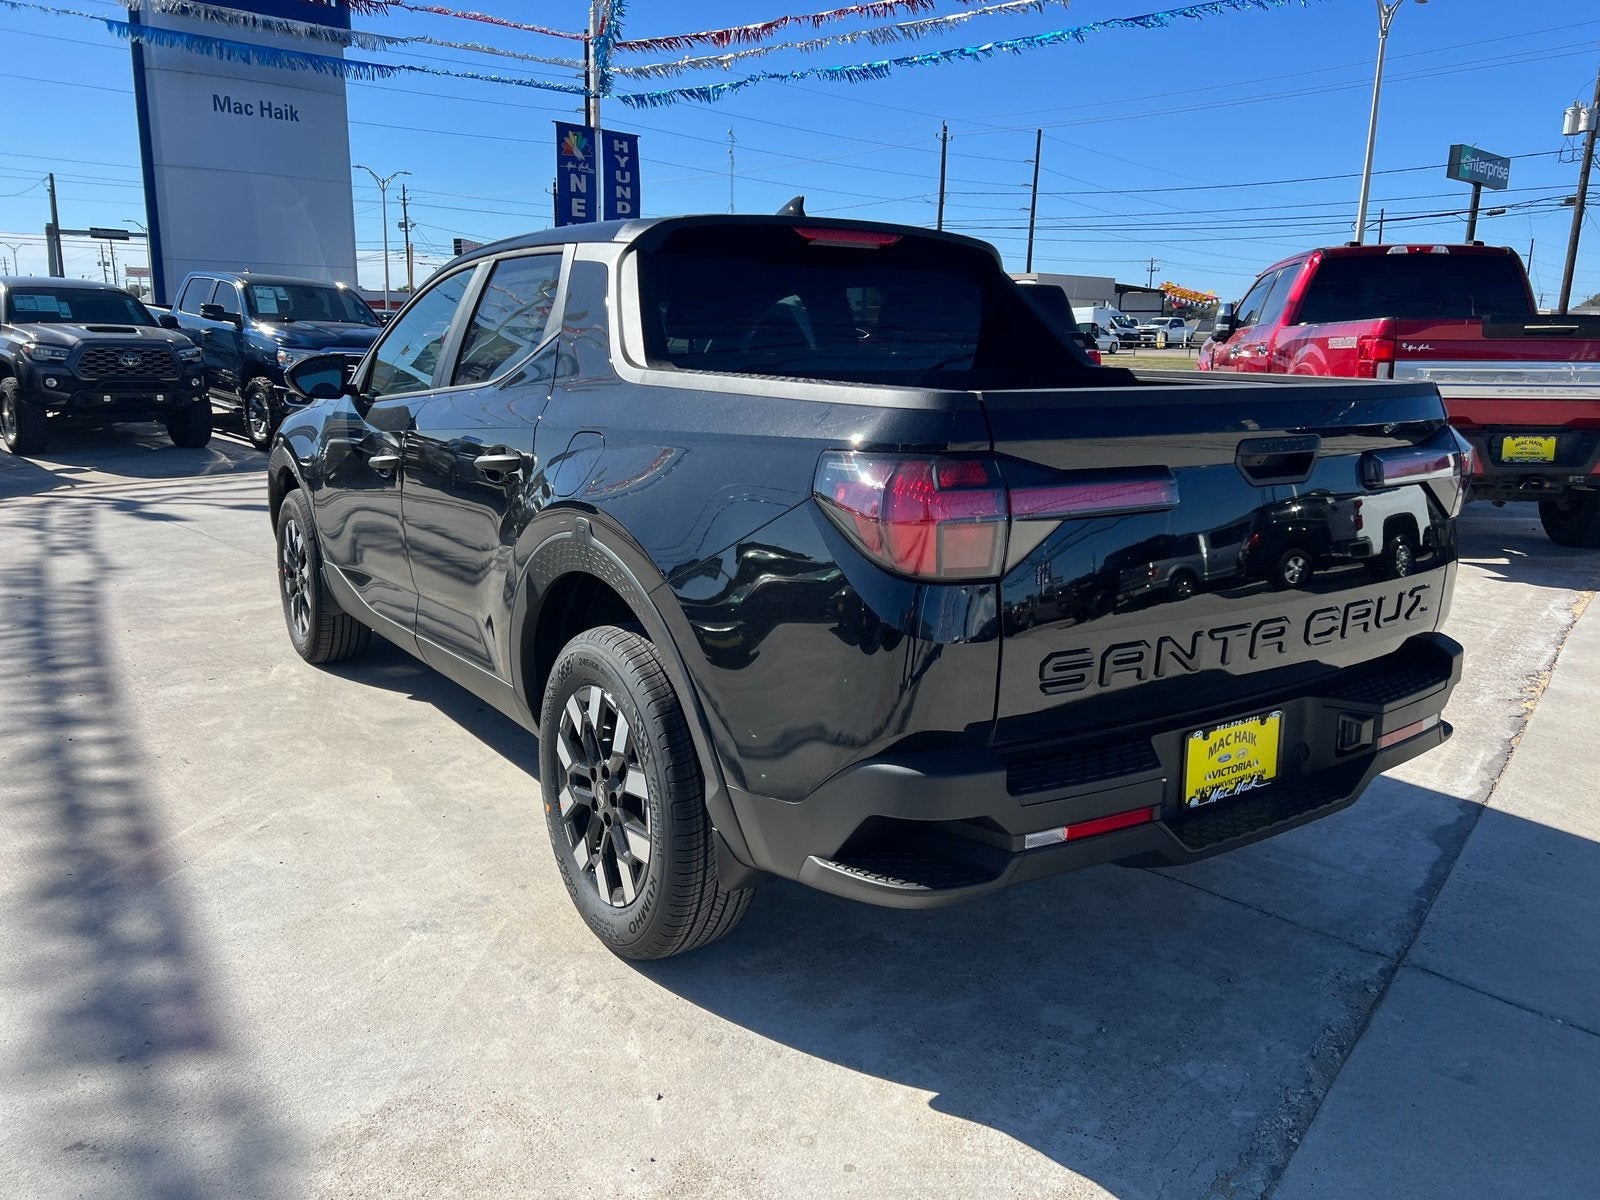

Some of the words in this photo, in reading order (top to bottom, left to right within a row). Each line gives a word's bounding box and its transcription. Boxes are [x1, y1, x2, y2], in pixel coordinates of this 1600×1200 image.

[212, 94, 254, 117] Mac
[259, 100, 300, 122] Haik
[613, 139, 632, 220] HYUND
[1461, 154, 1509, 180] enterprise
[570, 173, 587, 225] NE
[1038, 616, 1291, 696] SANTA
[1303, 584, 1431, 647] CRUZ
[1208, 733, 1232, 760] MAC
[1234, 731, 1257, 747] HAIK
[1211, 760, 1252, 779] VICTORIA
[1208, 787, 1233, 803] Mac
[1234, 776, 1268, 795] Haik
[629, 875, 657, 934] KUMHO
